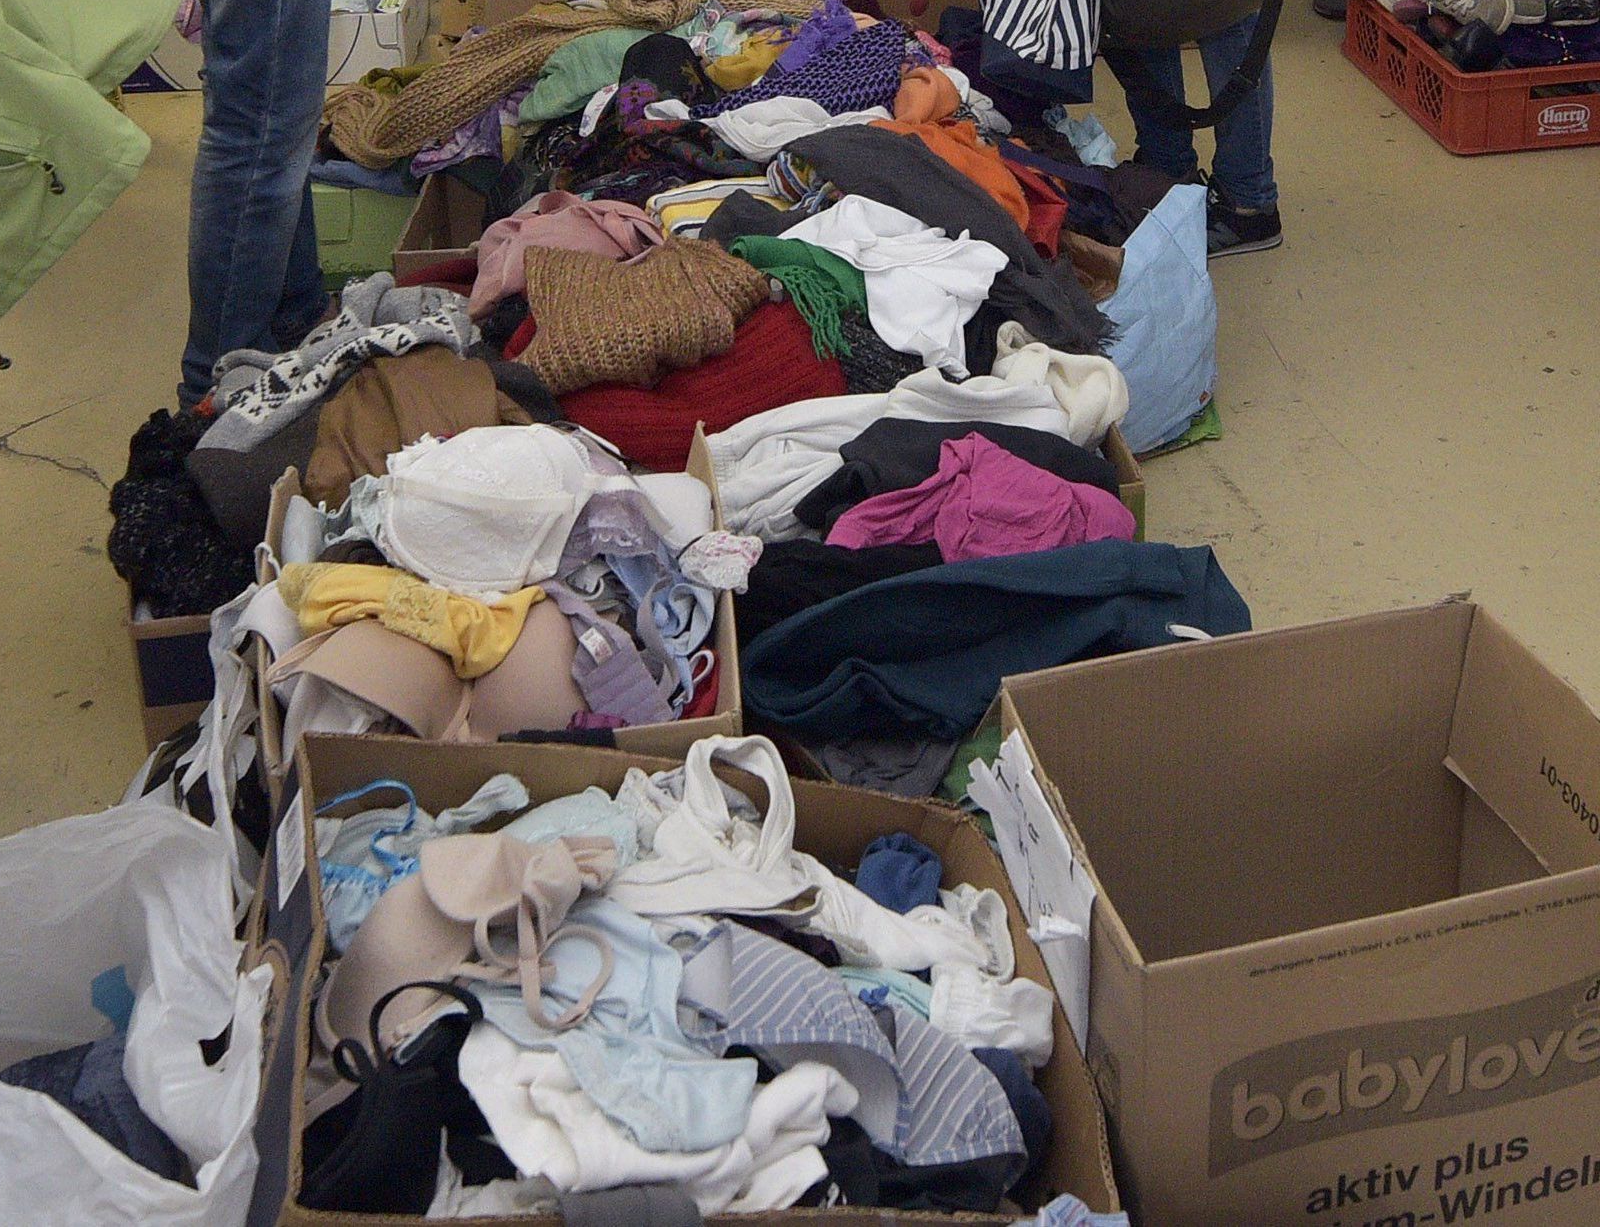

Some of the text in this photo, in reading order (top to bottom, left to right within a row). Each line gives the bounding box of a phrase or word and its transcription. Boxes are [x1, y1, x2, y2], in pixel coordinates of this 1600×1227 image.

[1542, 107, 1588, 125] Harry
[1539, 755, 1600, 840] 0403-01
[1231, 1020, 1600, 1141] babylove
[1305, 1135, 1531, 1216] aktiv plus
